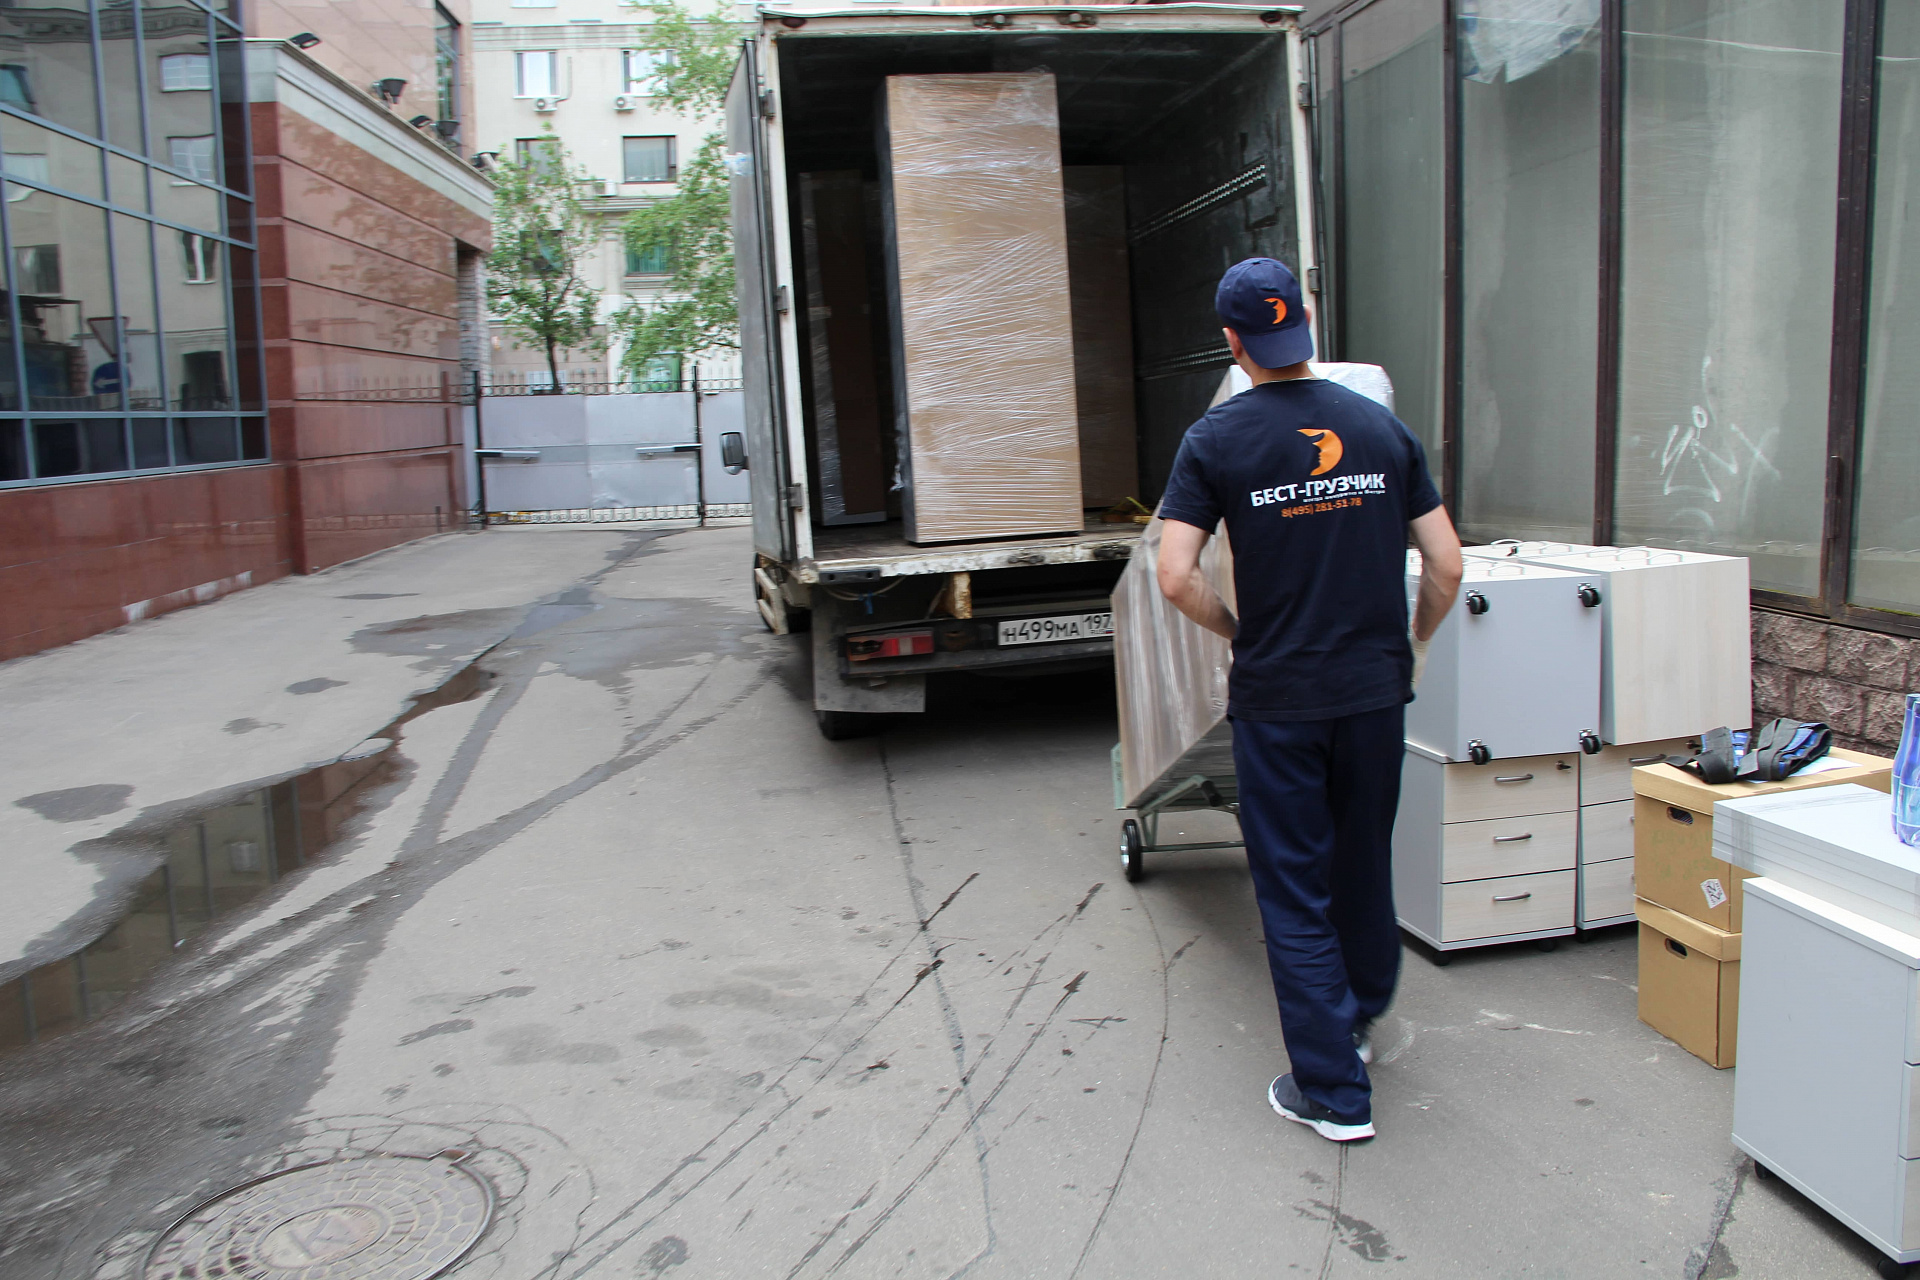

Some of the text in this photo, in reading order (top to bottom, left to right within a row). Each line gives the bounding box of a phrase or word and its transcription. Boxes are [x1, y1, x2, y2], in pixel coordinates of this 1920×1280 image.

[1250, 473, 1386, 507] БЕСТ-ГРУЗЧИК
[1281, 497, 1363, 518] 8(495) 281-51-78
[1083, 614, 1112, 630] 197
